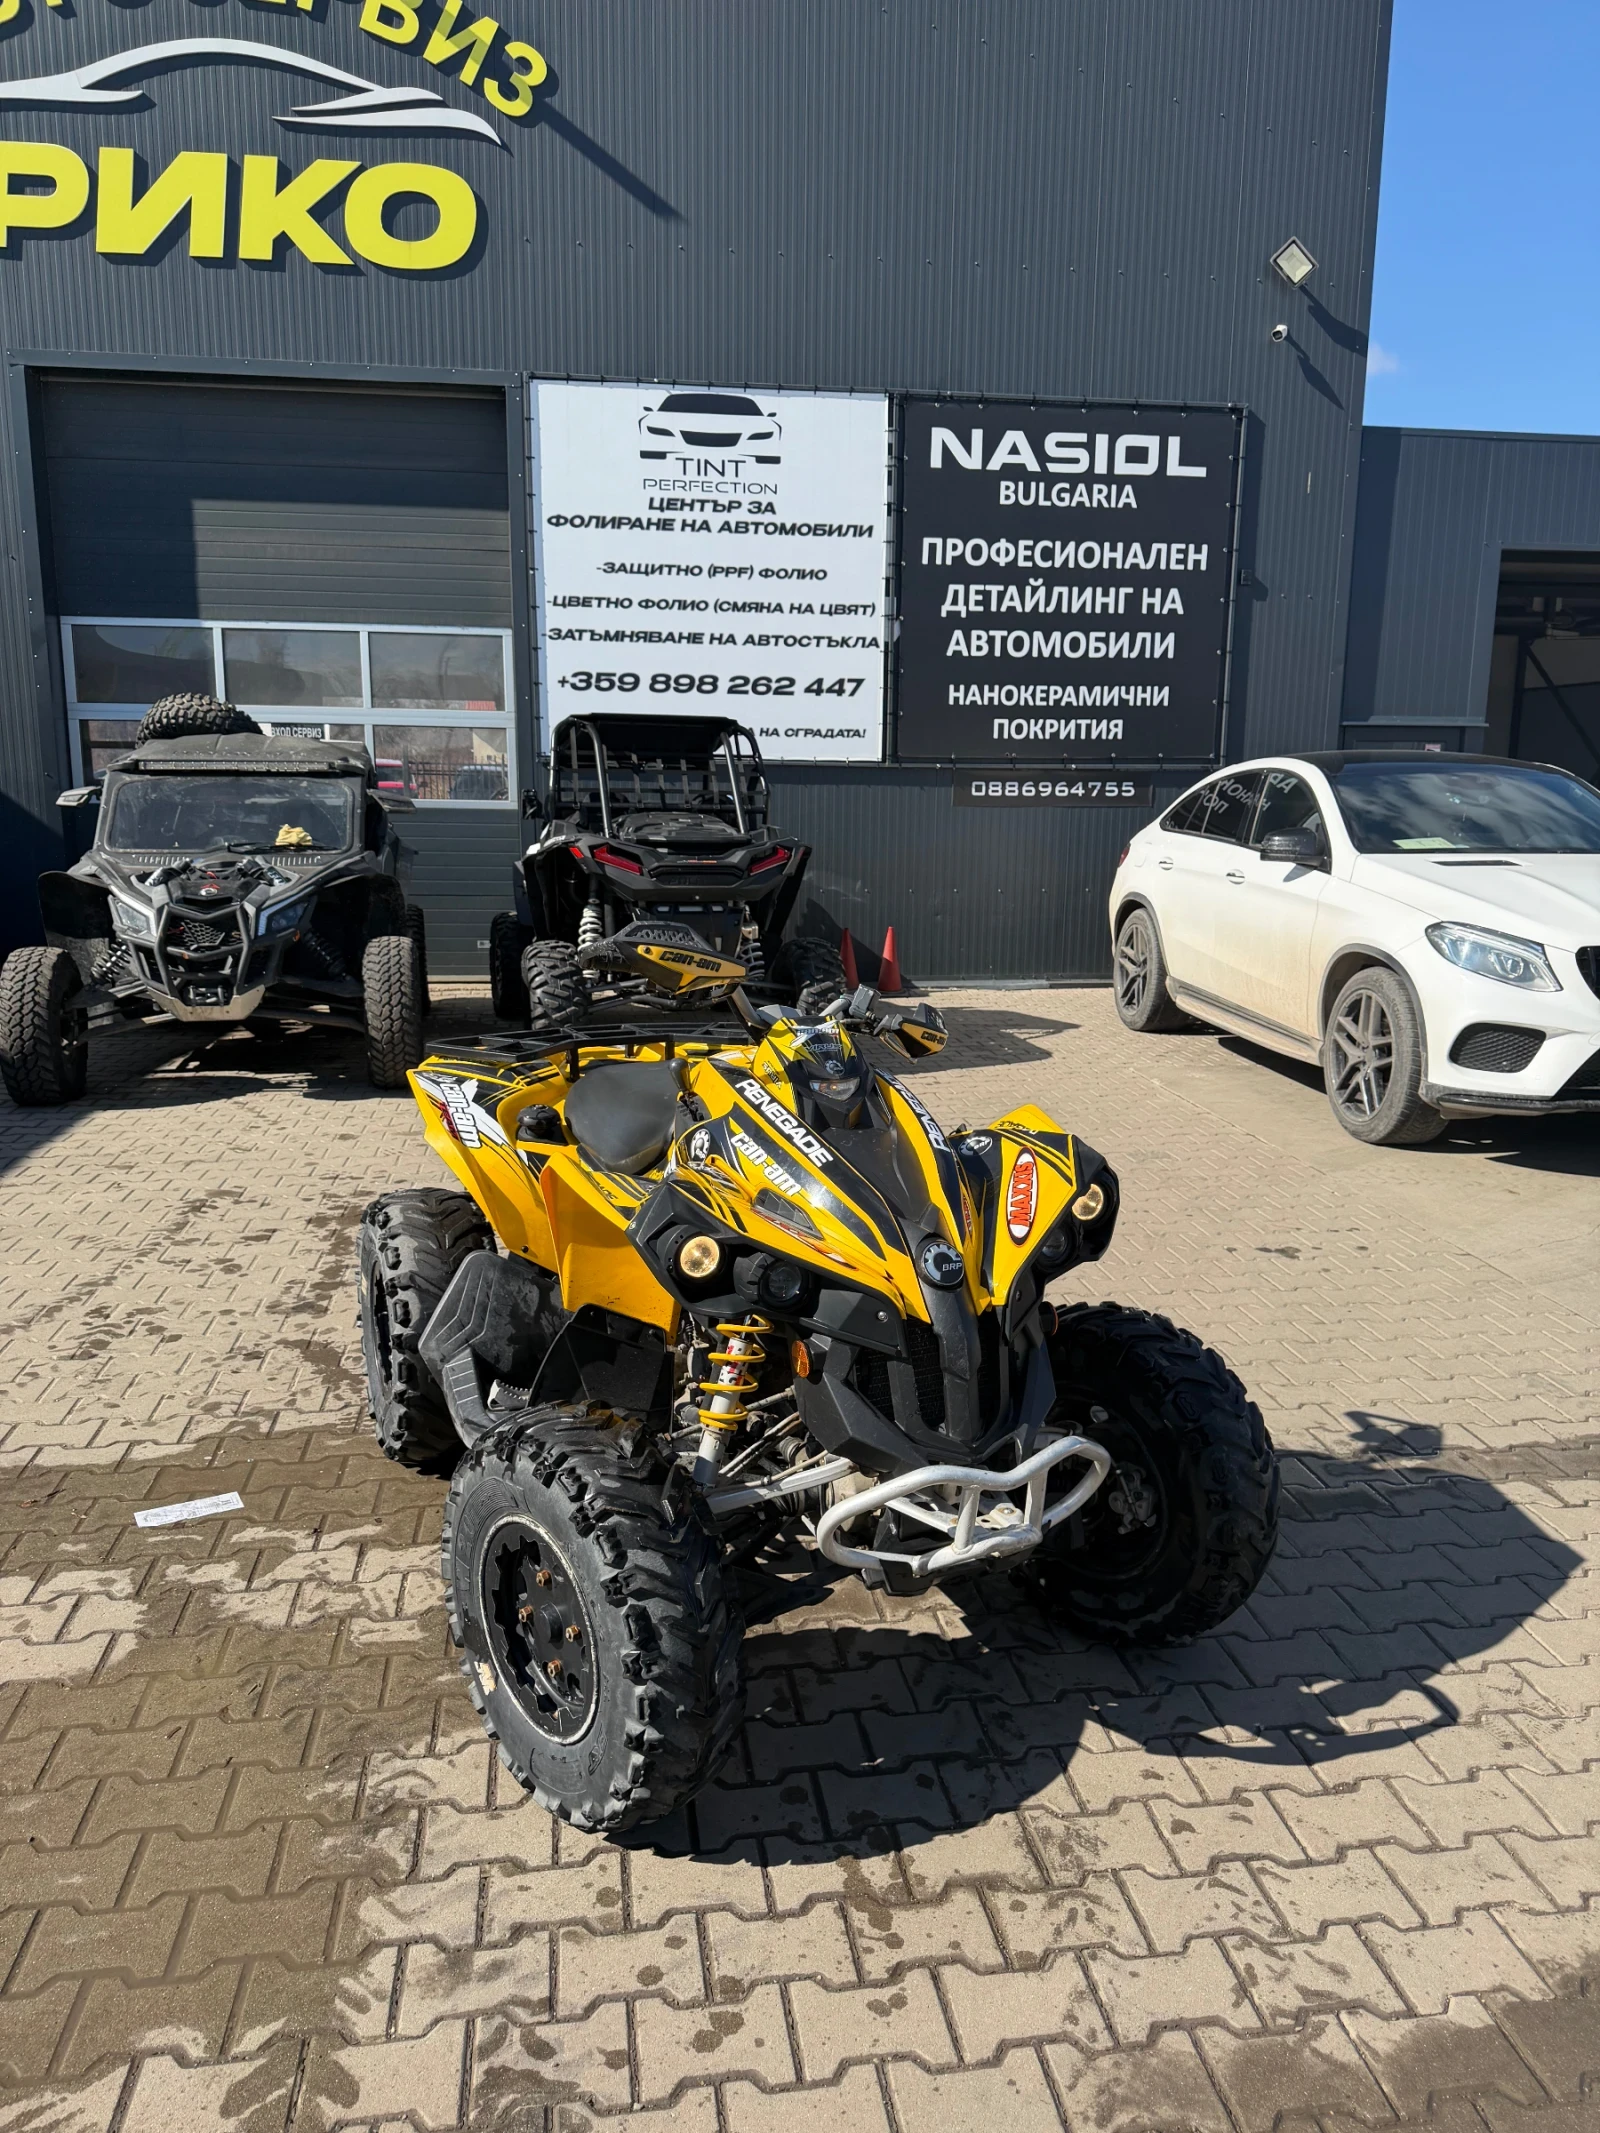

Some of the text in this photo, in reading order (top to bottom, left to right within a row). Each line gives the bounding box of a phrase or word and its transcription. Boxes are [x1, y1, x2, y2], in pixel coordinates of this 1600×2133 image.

[930, 426, 1207, 478] NASIOL
[675, 457, 747, 478] TINT
[643, 479, 778, 495] PERFECTION
[999, 480, 1138, 509] BULGARIA
[648, 497, 777, 515] ЦЕНТЪР ЗА
[546, 514, 875, 538] ФОЛИРАНЕ НА АВТОМОБИЛИ
[921, 537, 1209, 571] ПРОФЕСИОНАЛЕН
[707, 563, 755, 581] (PPF)
[758, 566, 828, 581] ФОЛИО
[637, 598, 709, 612] ФОЛИО
[713, 599, 785, 615] (СМЯНА
[788, 602, 815, 616] НА
[819, 602, 876, 618] ЦВЯТ)
[941, 578, 1184, 618] ДЕТАЙЛИНГ НА
[709, 632, 737, 646] НА
[742, 633, 881, 649] АВТОСТЪКЛА
[946, 629, 1176, 659] АВТОМОБИЛИ
[557, 671, 866, 698] +359 898 262 447
[948, 684, 1170, 707] НАНОКЕРАМИЧНИ
[292, 727, 322, 738] СЕРВИЗ
[759, 727, 780, 738] НА
[784, 727, 867, 739] СГРАДАТА!
[993, 718, 1124, 740] ПОКРИТИЯ
[971, 781, 1136, 798] 0886964755
[659, 950, 722, 973] can-am
[440, 1083, 483, 1149] can-am
[735, 1078, 833, 1167] RENEGADE
[730, 1131, 802, 1197] can-am
[1009, 1161, 1035, 1227] MAXXIS
[942, 1262, 963, 1272] BRP
